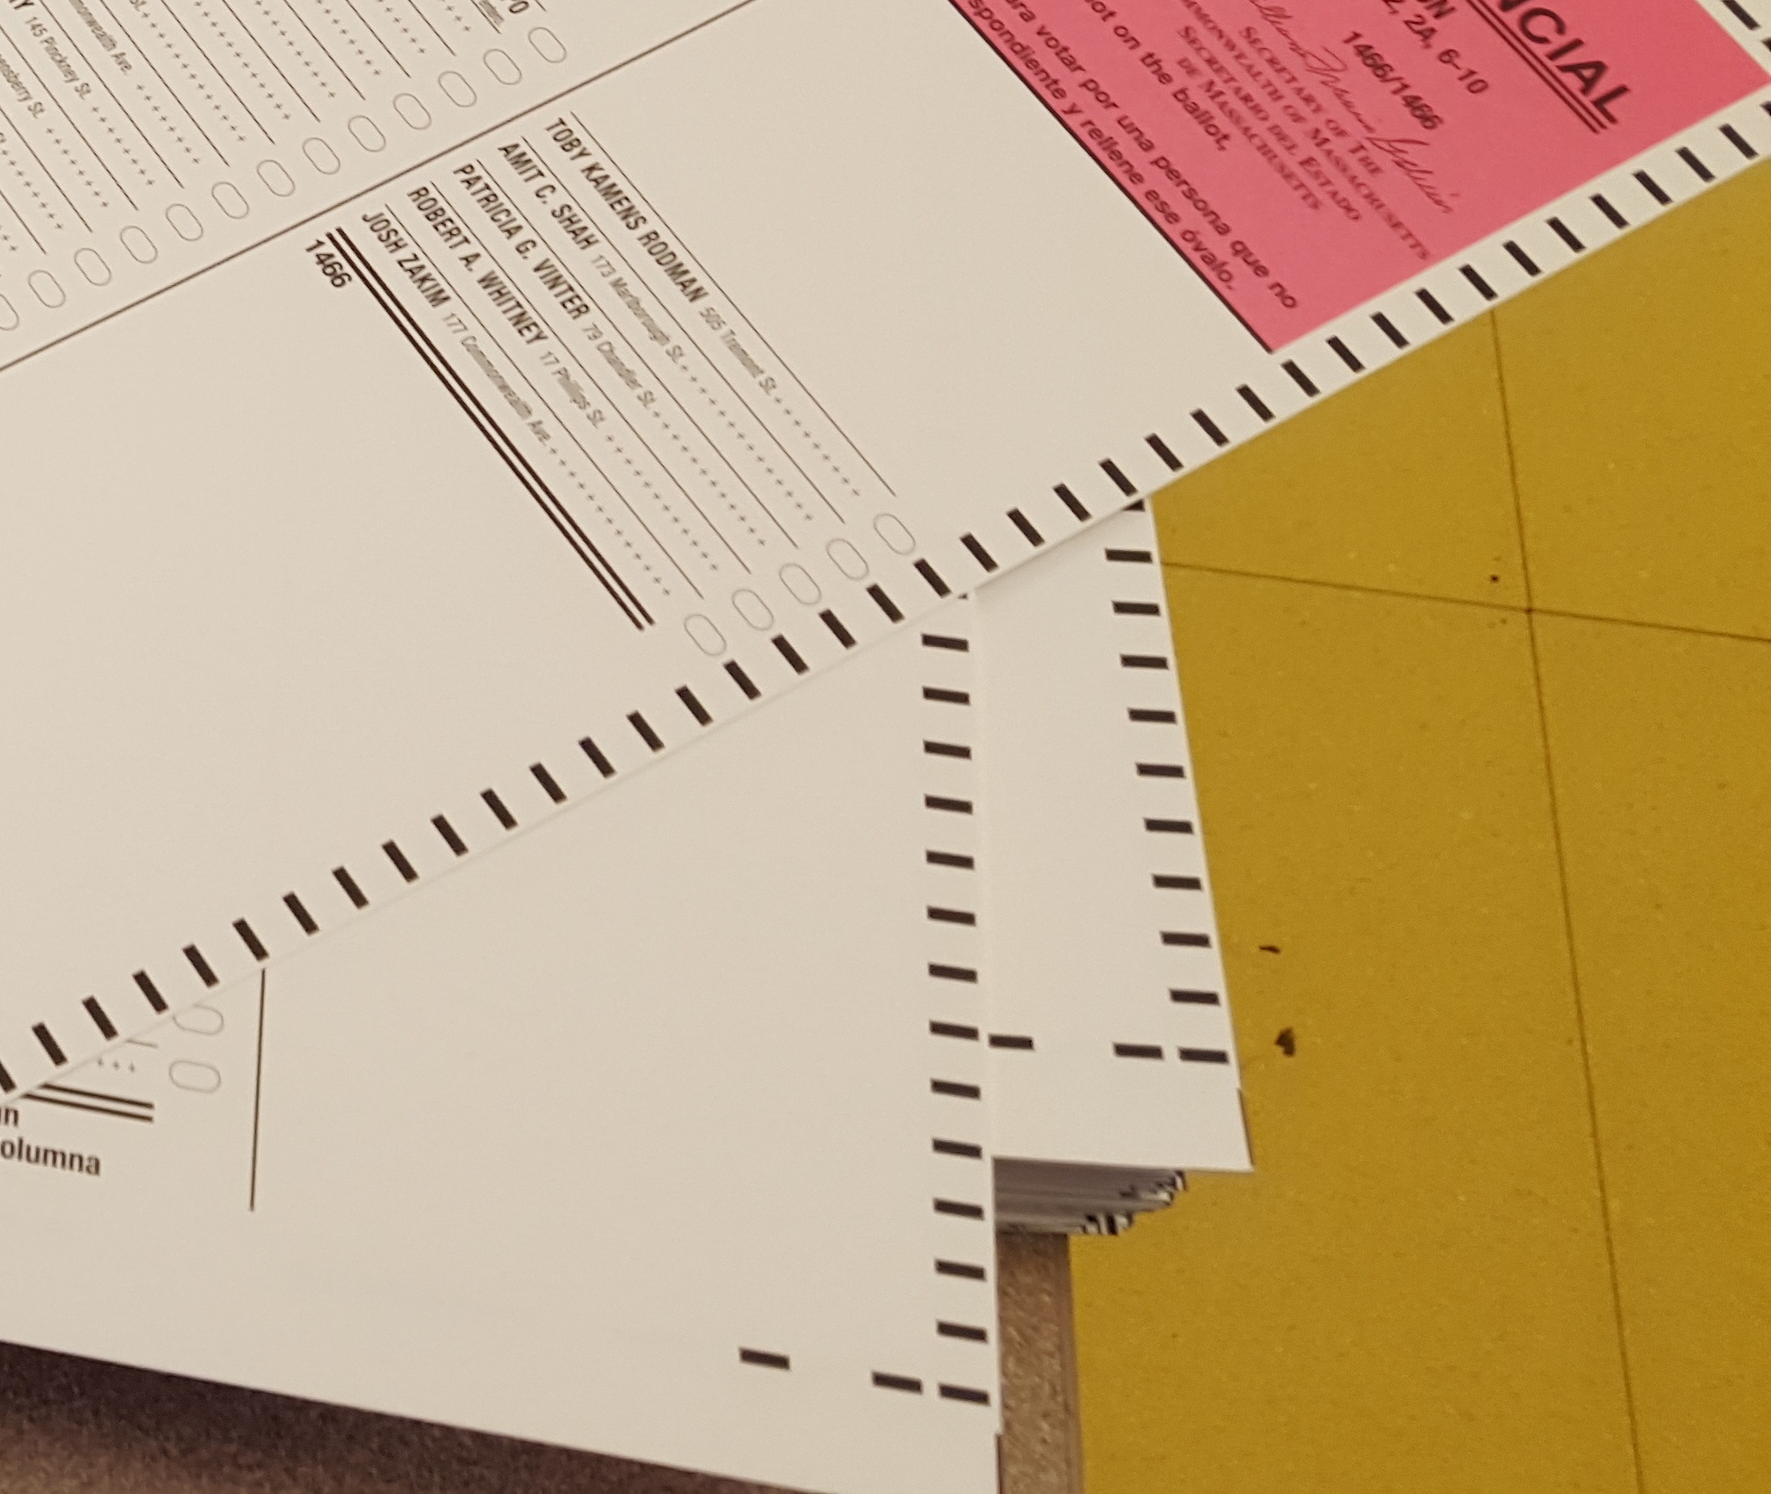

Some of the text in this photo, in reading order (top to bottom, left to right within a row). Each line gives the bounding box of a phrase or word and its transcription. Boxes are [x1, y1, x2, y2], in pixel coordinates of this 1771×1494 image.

[305, 239, 353, 288] 1466
[361, 214, 451, 308] JOSH ZAKIM
